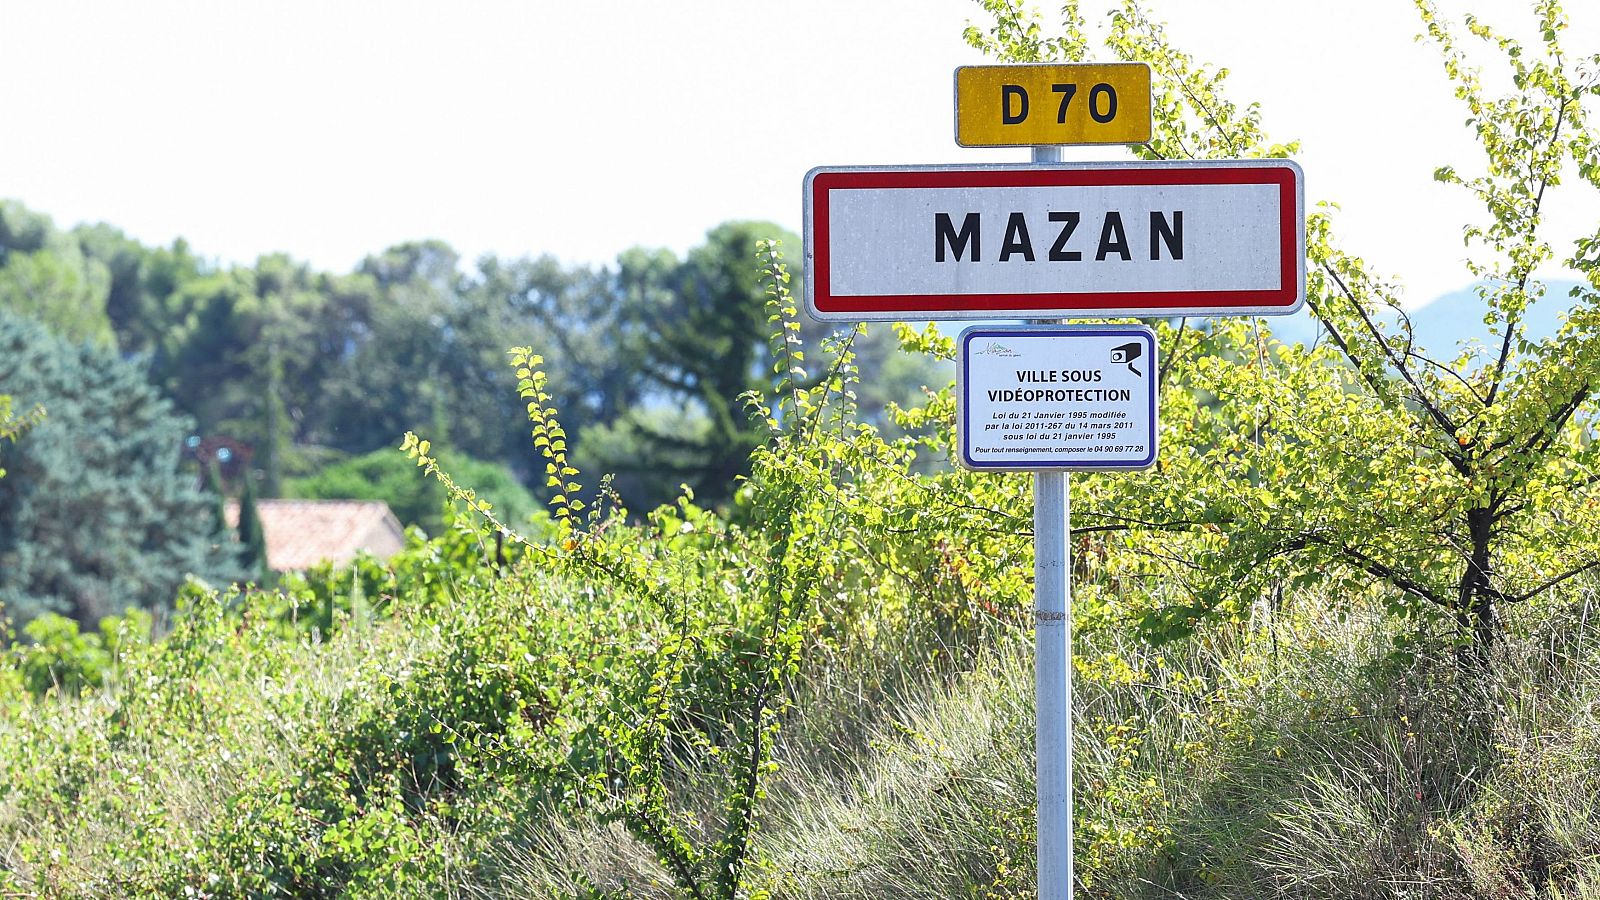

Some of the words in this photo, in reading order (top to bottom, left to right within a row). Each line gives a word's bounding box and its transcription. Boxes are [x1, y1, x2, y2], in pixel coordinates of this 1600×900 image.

[1001, 85, 1030, 125] D
[1051, 83, 1118, 124] 70
[934, 211, 1184, 263] MAZAN
[1016, 370, 1057, 382] VILLE
[1061, 370, 1102, 382] SOUS
[988, 388, 1130, 402] VIDÉOPROTECTION
[1068, 411, 1088, 419] 1995
[1089, 411, 1126, 419] modifiée
[985, 423, 999, 431] par
[1064, 432, 1094, 441] janvier
[1097, 432, 1116, 440] 1995
[1005, 446, 1053, 454] renseignement,
[1054, 446, 1086, 454] composer
[1094, 445, 1103, 453] 04
[1104, 445, 1114, 453] 90
[1114, 445, 1124, 453] 69
[1124, 445, 1134, 453] 77
[1134, 445, 1144, 453] 28
